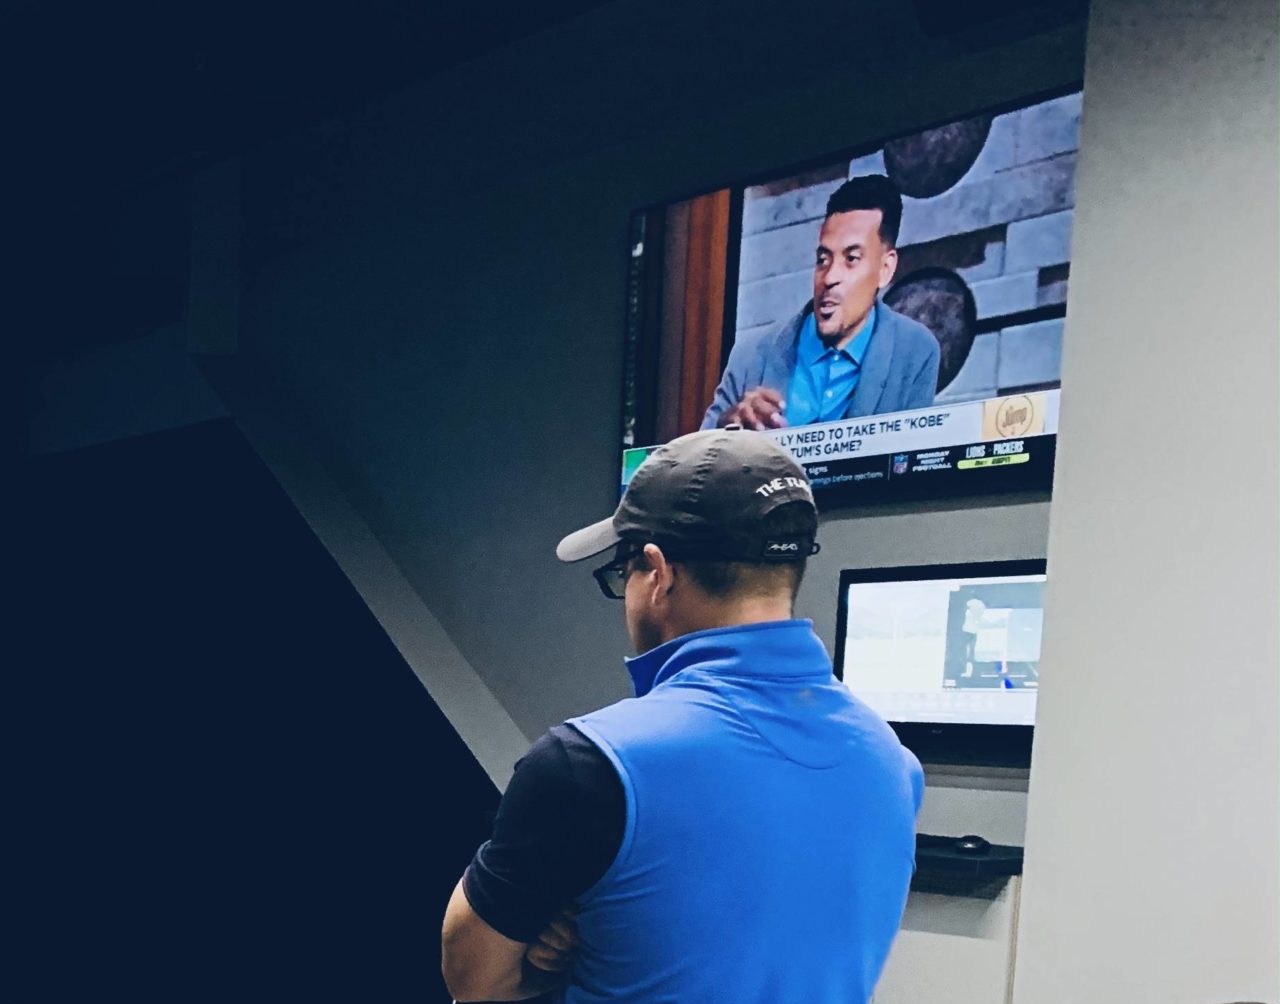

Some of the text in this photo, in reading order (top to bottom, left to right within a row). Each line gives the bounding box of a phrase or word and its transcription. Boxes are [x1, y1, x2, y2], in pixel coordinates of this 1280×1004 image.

[776, 434, 794, 446] LY
[797, 431, 825, 444] NEED
[828, 428, 844, 440] TO
[847, 423, 876, 437] TAKE
[880, 420, 901, 433] THE
[824, 439, 862, 455] GAME?
[912, 462, 952, 472] FOOTBALL
[756, 478, 786, 497] THE
